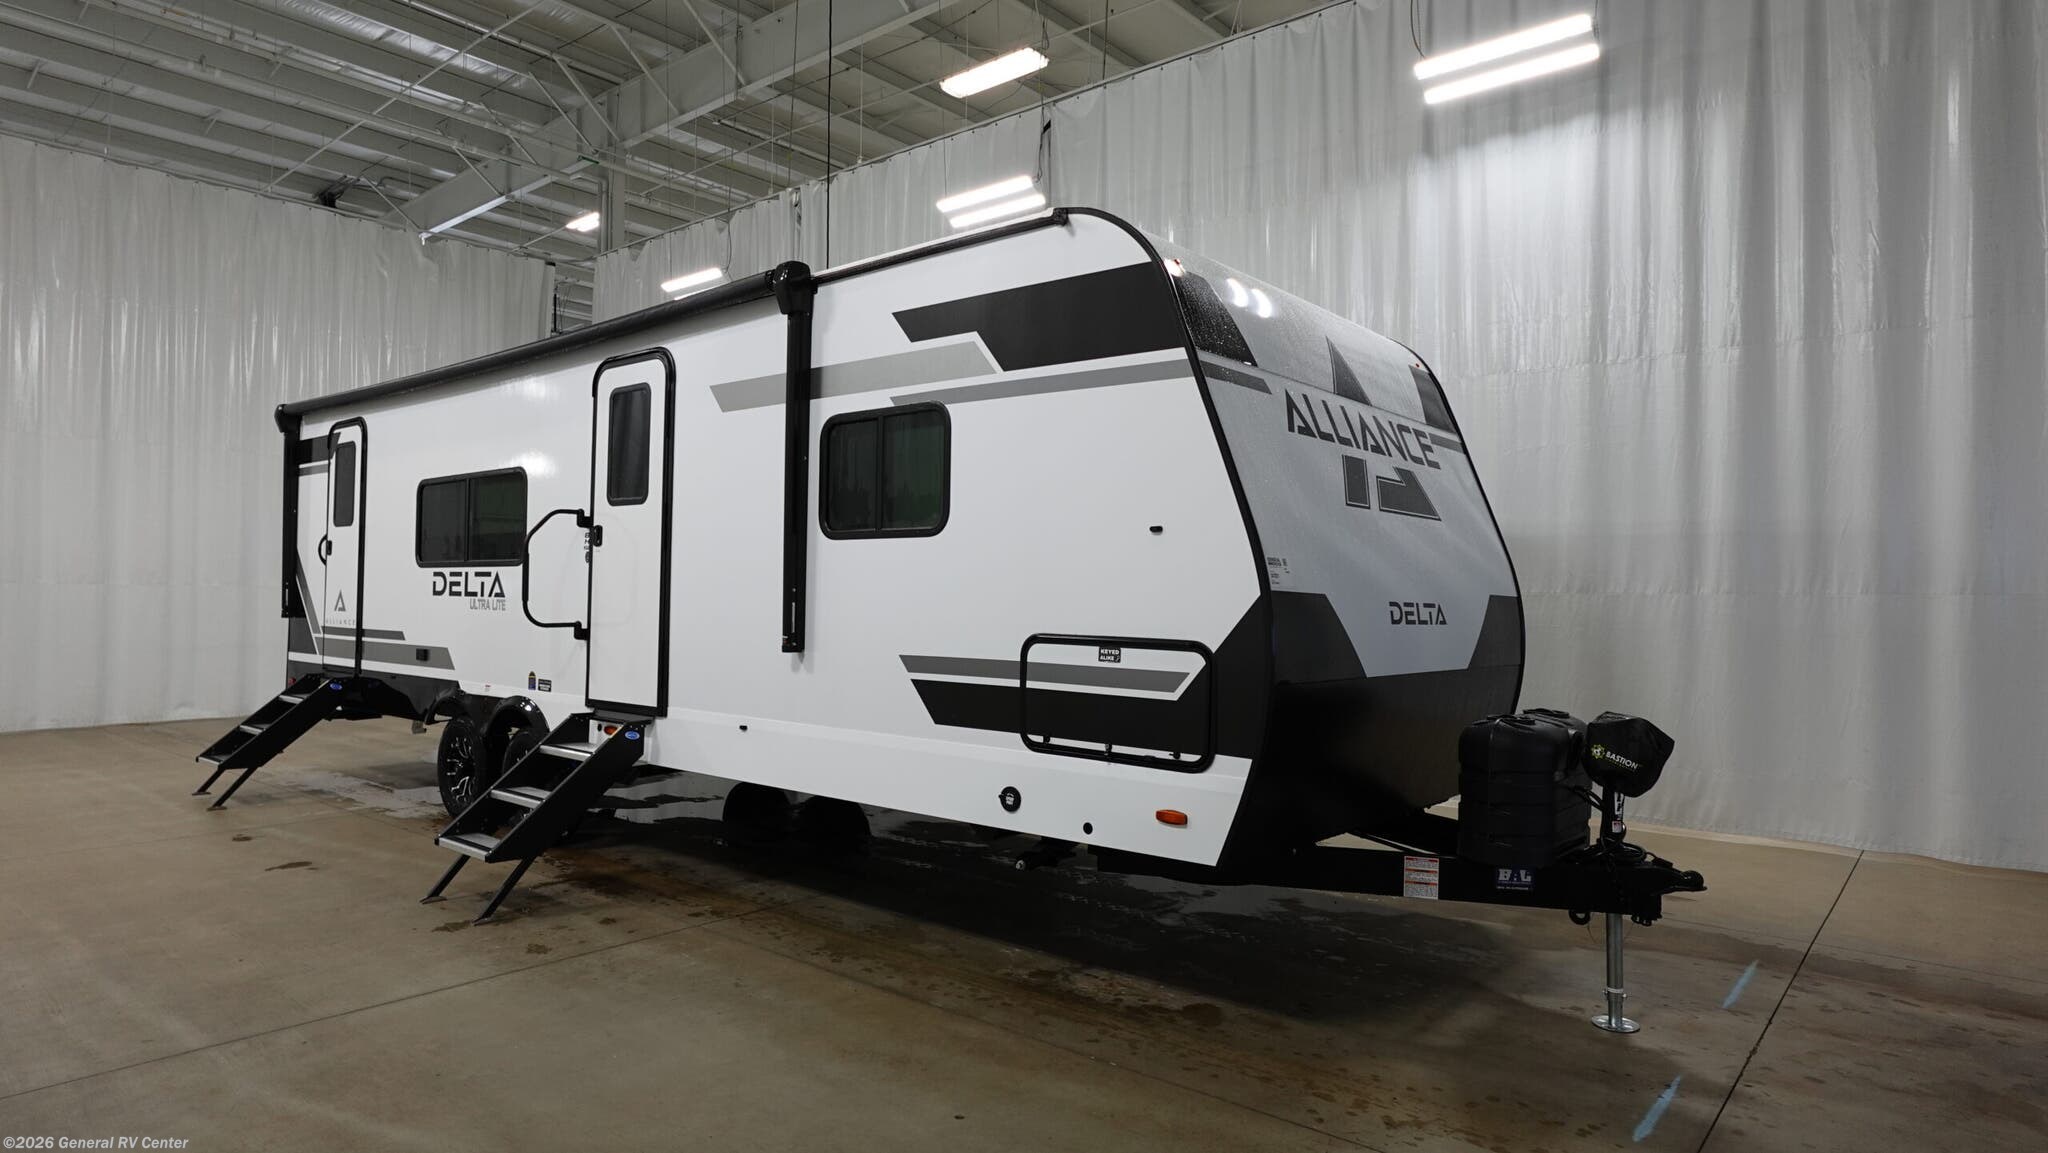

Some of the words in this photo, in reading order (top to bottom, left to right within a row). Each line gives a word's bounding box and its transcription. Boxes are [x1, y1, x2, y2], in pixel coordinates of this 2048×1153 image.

[1285, 388, 1441, 470] ALLIANCE
[433, 571, 506, 597] DELTA
[469, 599, 490, 610] ULTRA
[491, 600, 506, 611] LITE
[1389, 601, 1448, 626] DELTA
[1605, 750, 1639, 769] BASTION
